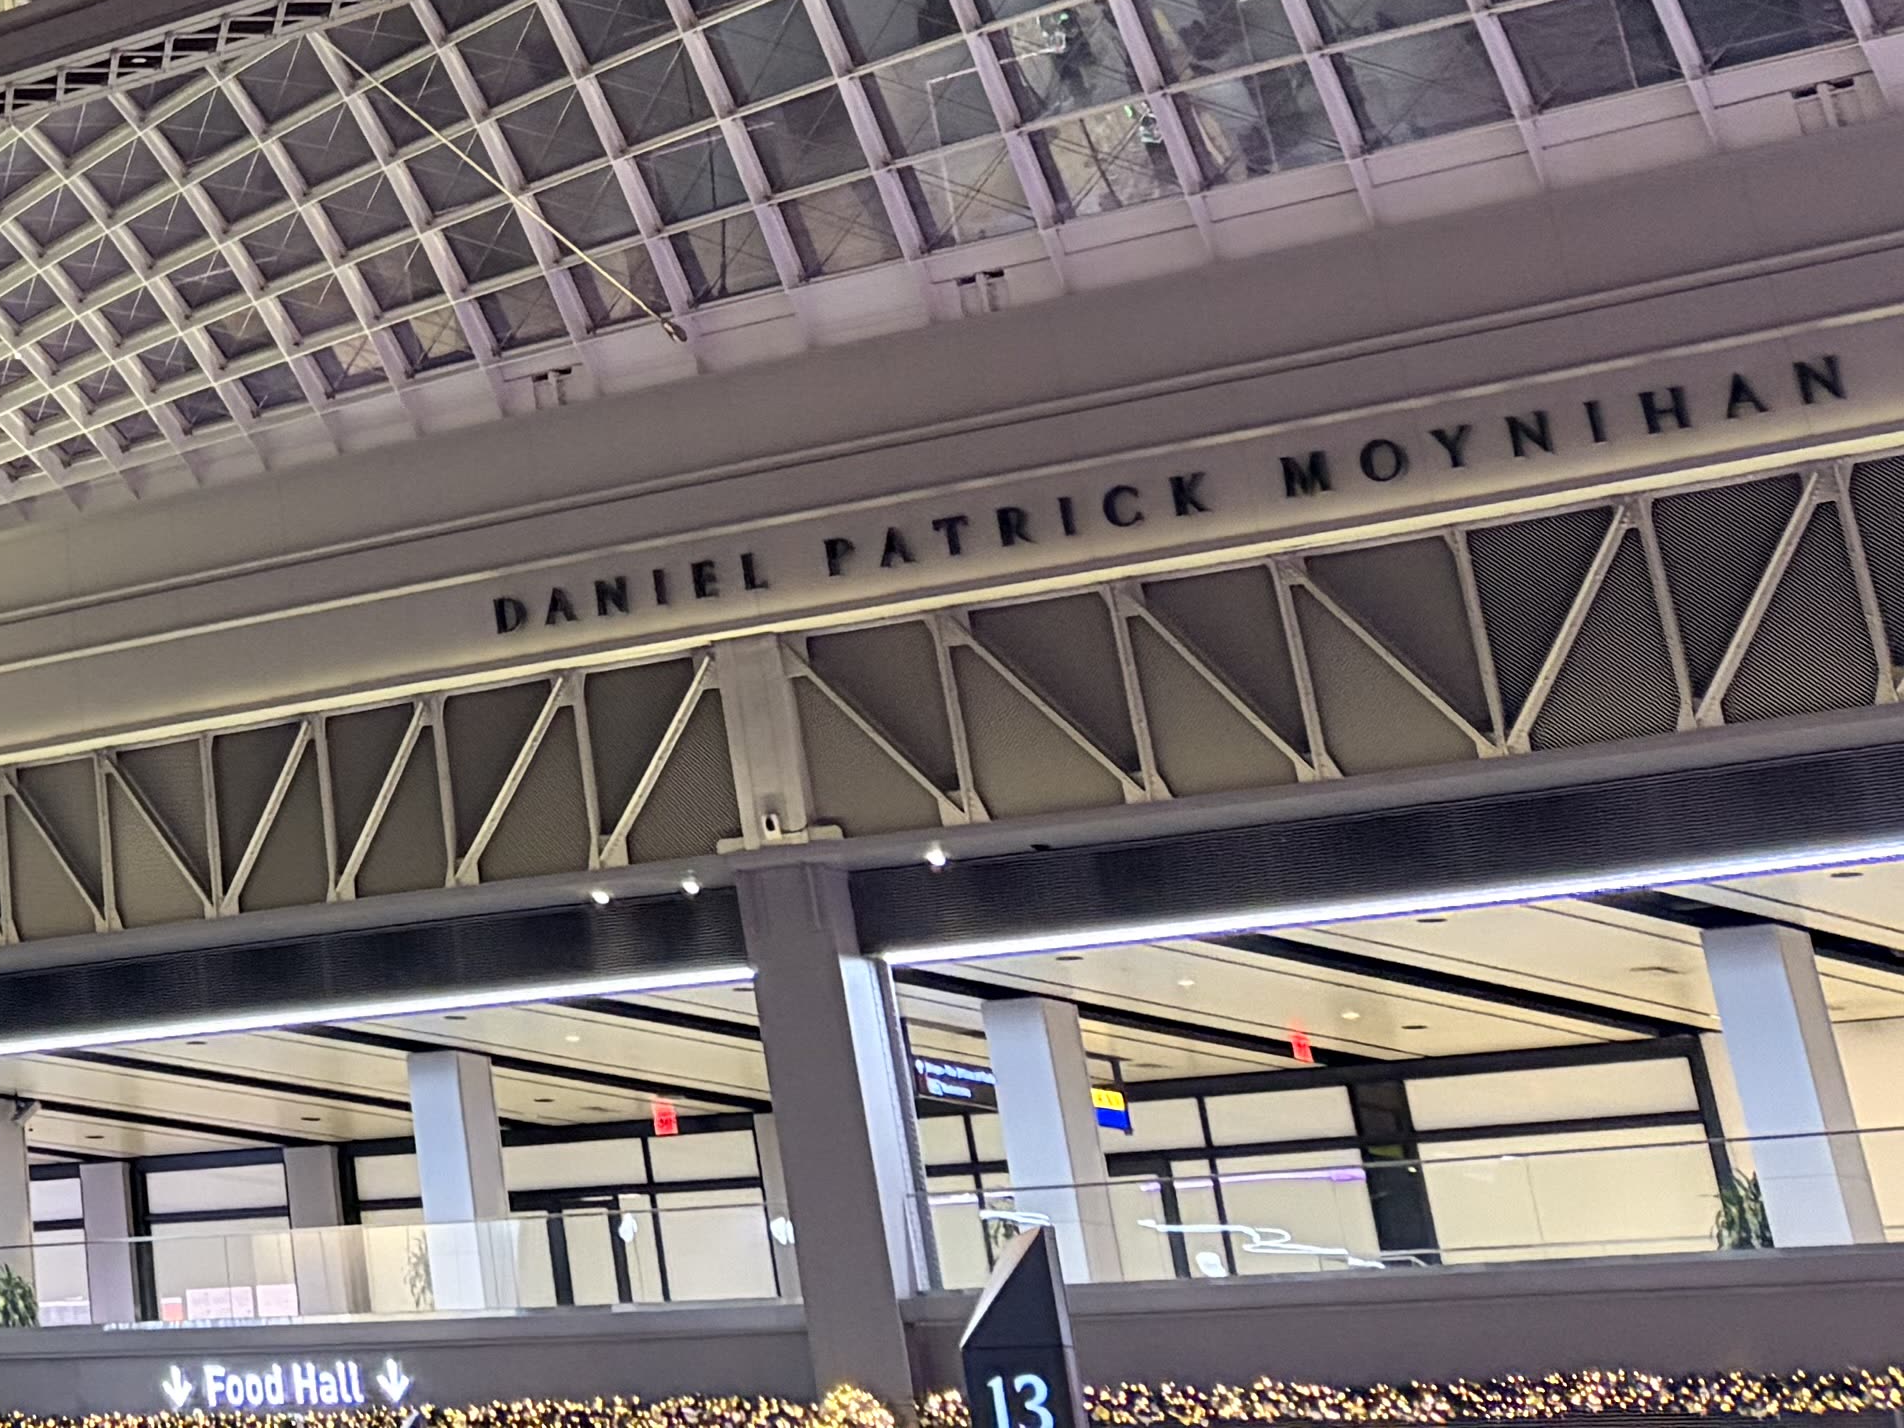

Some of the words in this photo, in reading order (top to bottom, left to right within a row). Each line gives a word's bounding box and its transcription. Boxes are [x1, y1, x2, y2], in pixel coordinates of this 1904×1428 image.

[492, 551, 772, 634] DANIEL
[823, 471, 1210, 578] PATRICK
[1280, 353, 1848, 499] MOYNIHAN
[203, 1362, 285, 1407] Food
[293, 1360, 365, 1405] Hall
[986, 1374, 1054, 1428] 13
